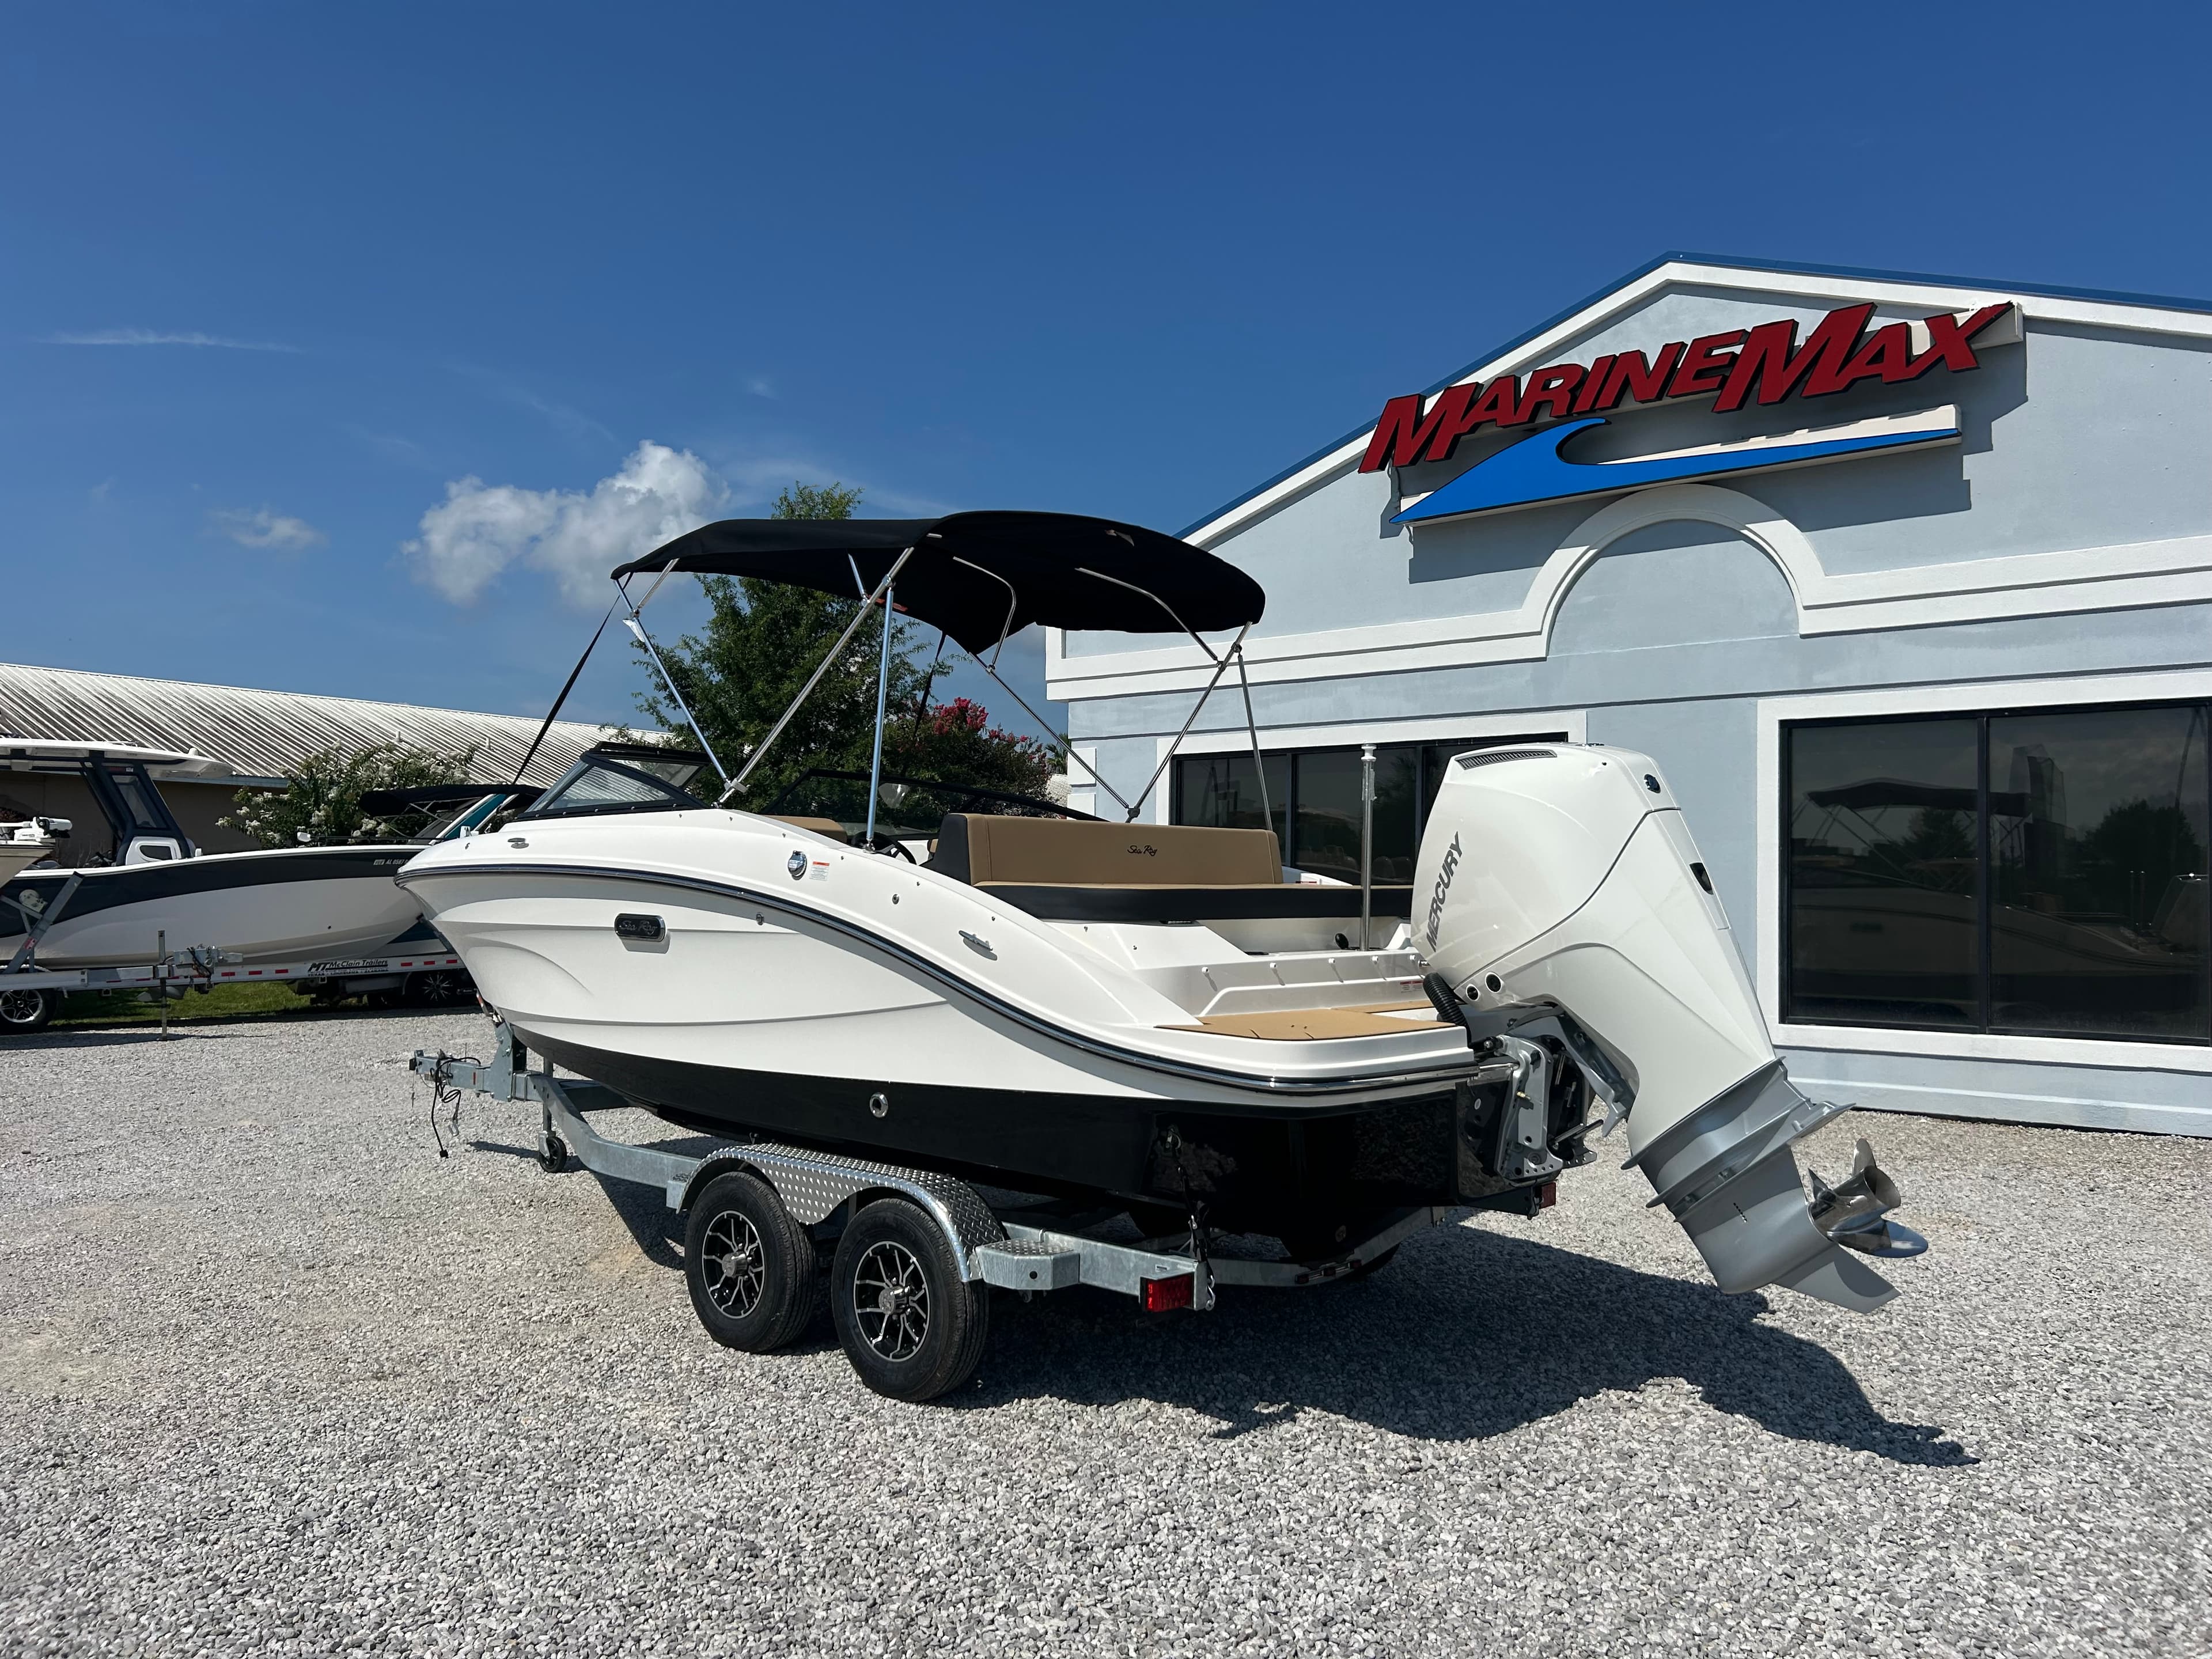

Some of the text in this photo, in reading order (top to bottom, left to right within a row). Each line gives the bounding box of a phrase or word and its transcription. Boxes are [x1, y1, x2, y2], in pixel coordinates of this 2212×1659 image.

[1127, 845, 1157, 856] Sea Ray
[1426, 831, 1463, 952] MERCURY
